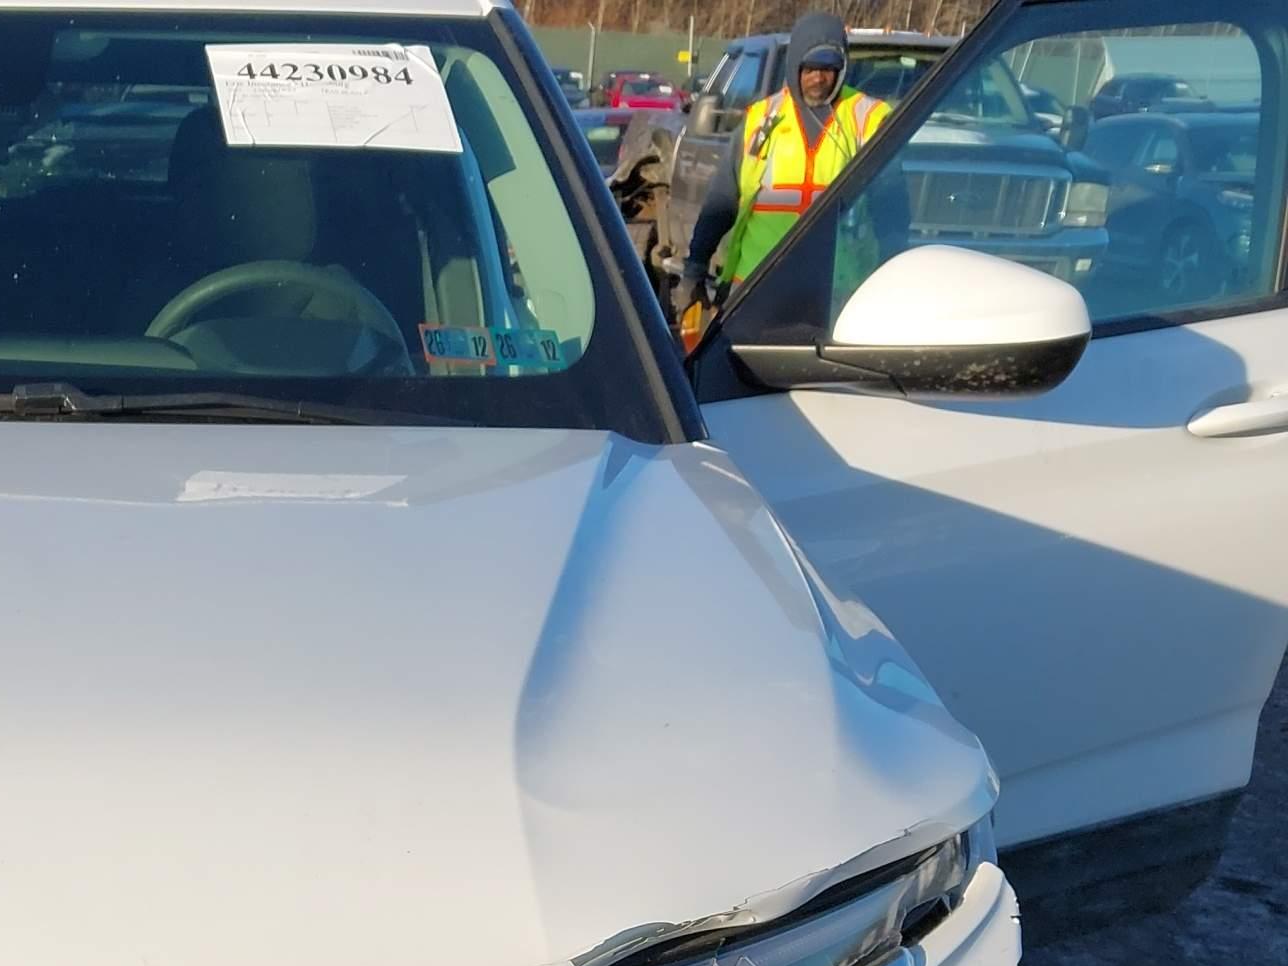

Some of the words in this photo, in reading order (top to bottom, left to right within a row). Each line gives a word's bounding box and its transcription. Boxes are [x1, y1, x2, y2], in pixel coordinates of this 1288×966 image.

[238, 62, 414, 86] 44230984
[472, 335, 489, 358] 12
[541, 339, 561, 361] 12
